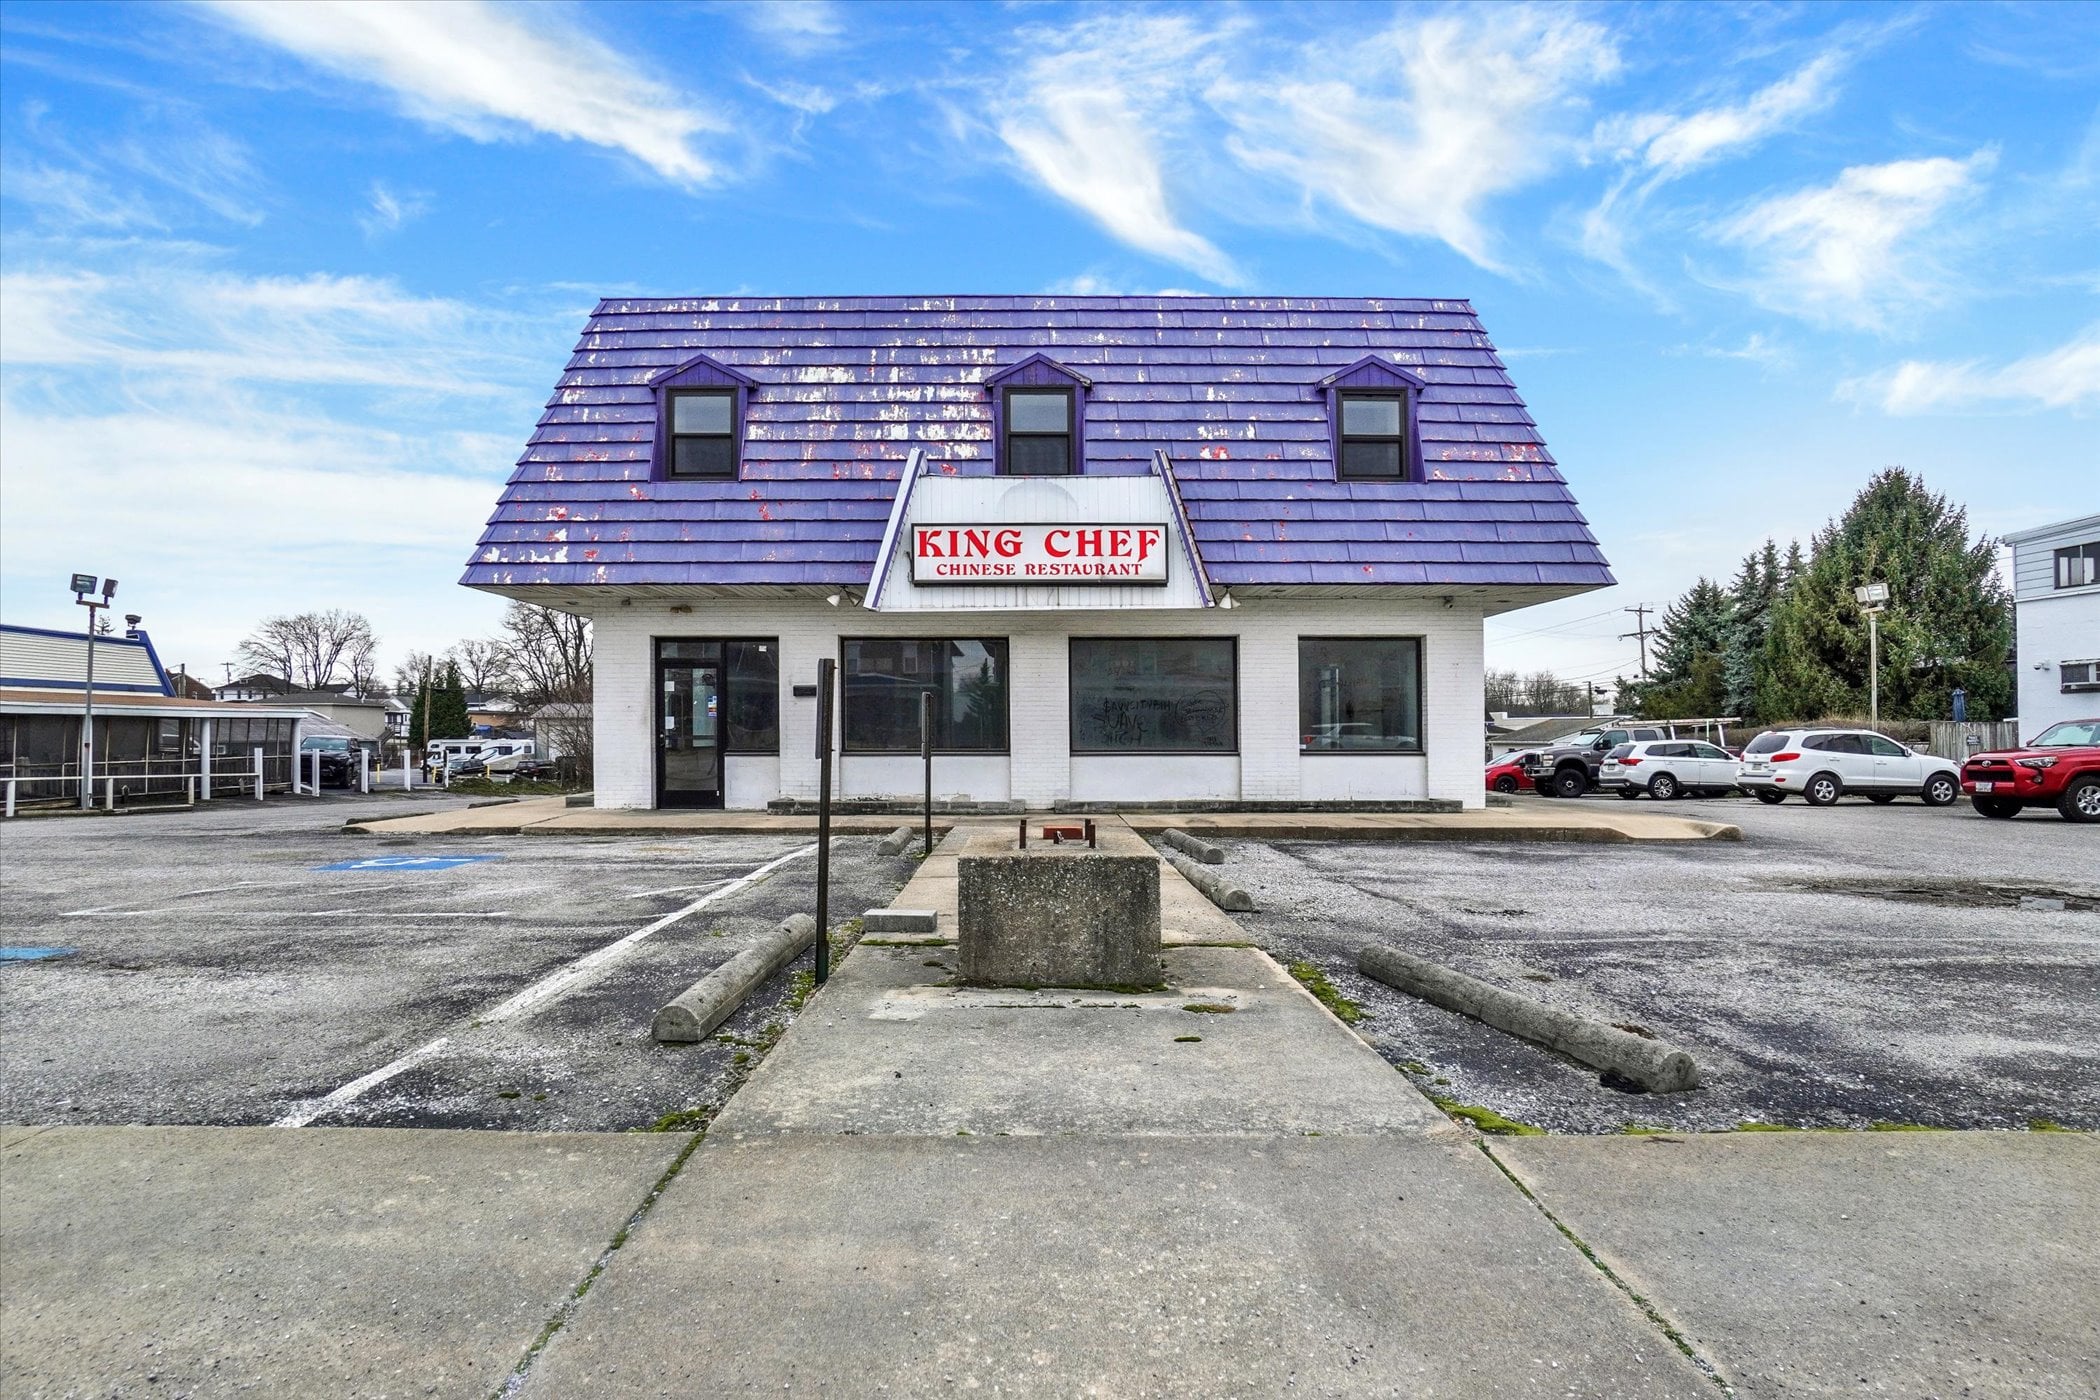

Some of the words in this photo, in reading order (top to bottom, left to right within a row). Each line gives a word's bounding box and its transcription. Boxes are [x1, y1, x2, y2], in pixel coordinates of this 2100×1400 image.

[917, 529, 1023, 559] KING
[1044, 529, 1160, 562] CHEF
[936, 563, 1016, 576] CHINESE
[1025, 563, 1142, 576] RESTAURANT
